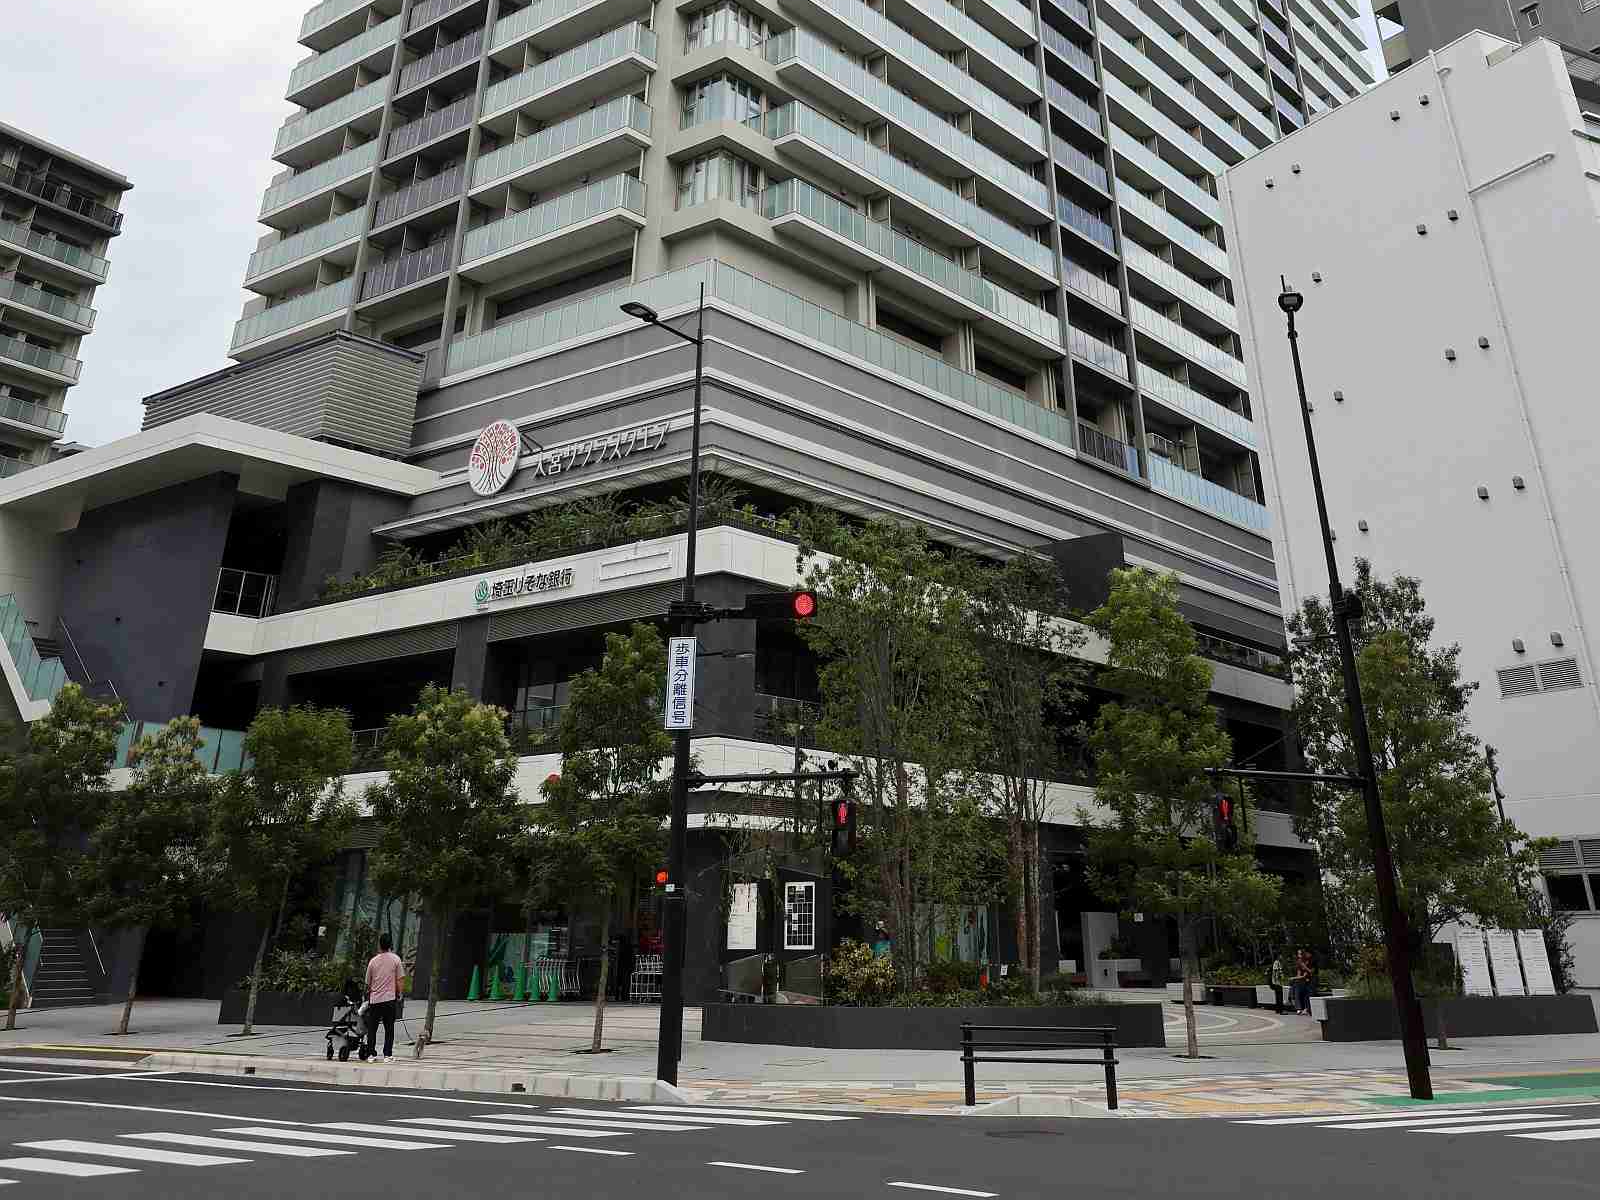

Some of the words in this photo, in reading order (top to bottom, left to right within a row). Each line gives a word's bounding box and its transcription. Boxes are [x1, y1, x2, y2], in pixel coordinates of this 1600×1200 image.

[492, 568, 573, 598] 埼玉りそな銀行
[672, 642, 690, 724] 歩車分離信号
